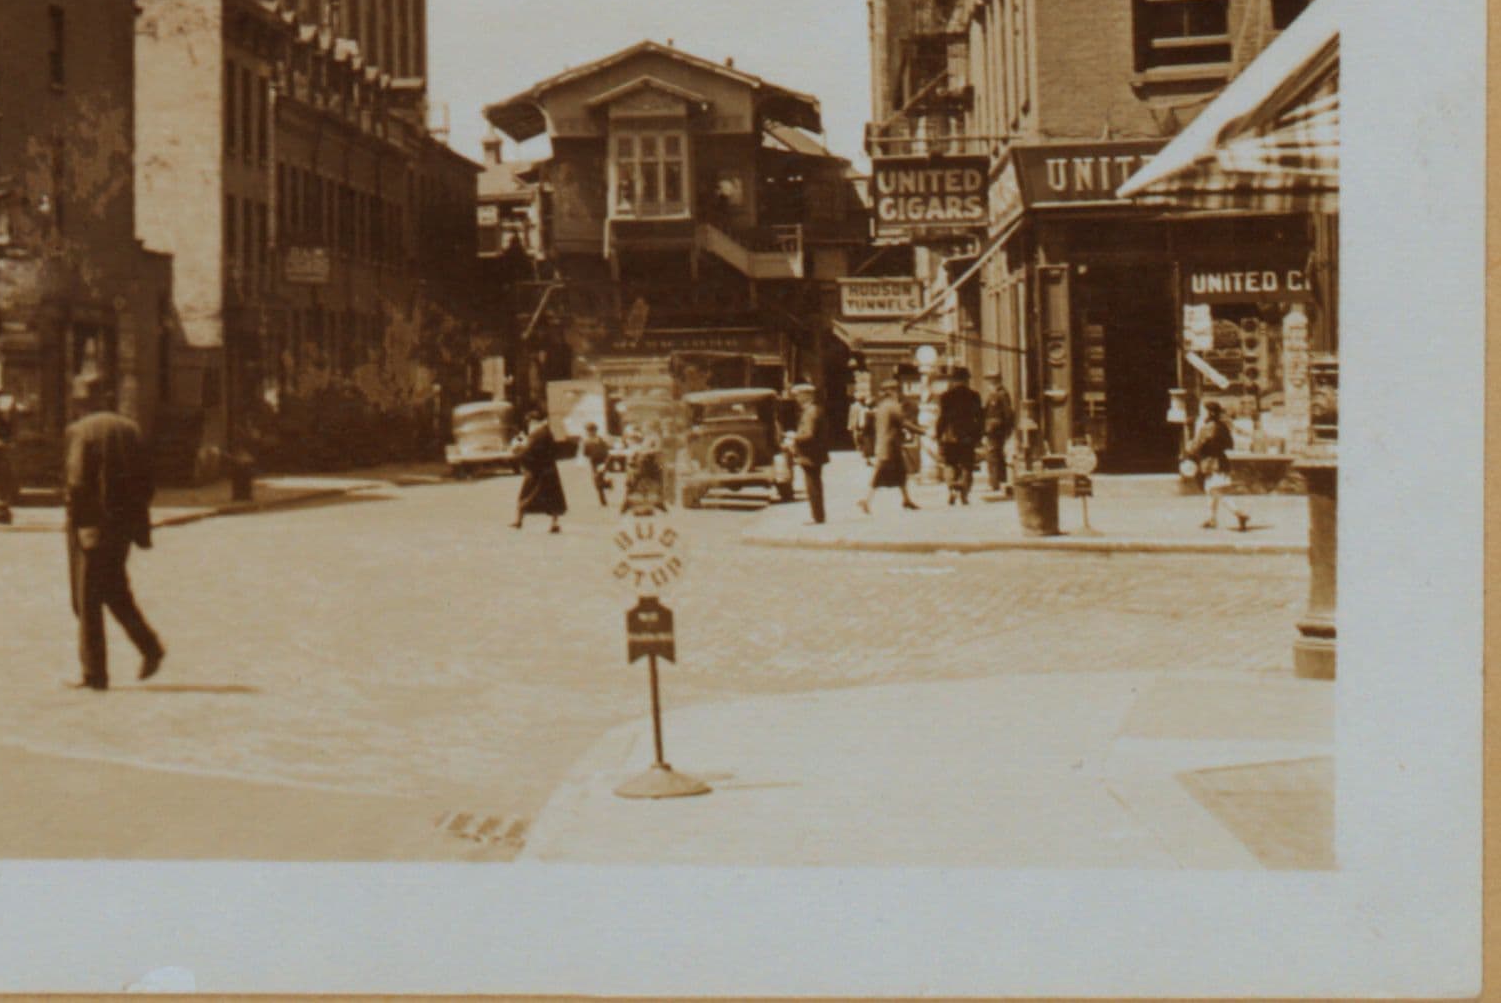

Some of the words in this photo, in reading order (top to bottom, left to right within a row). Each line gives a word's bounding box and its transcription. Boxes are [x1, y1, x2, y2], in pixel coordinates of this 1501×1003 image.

[875, 169, 982, 195] UNITED
[1045, 155, 1159, 191] UNIT
[878, 195, 984, 221] CIGARS
[849, 284, 912, 297] HUDSON
[1191, 270, 1278, 294] UNITED
[845, 299, 918, 312] TUNNELS
[612, 523, 678, 552] BUS
[612, 557, 682, 588] STOP
